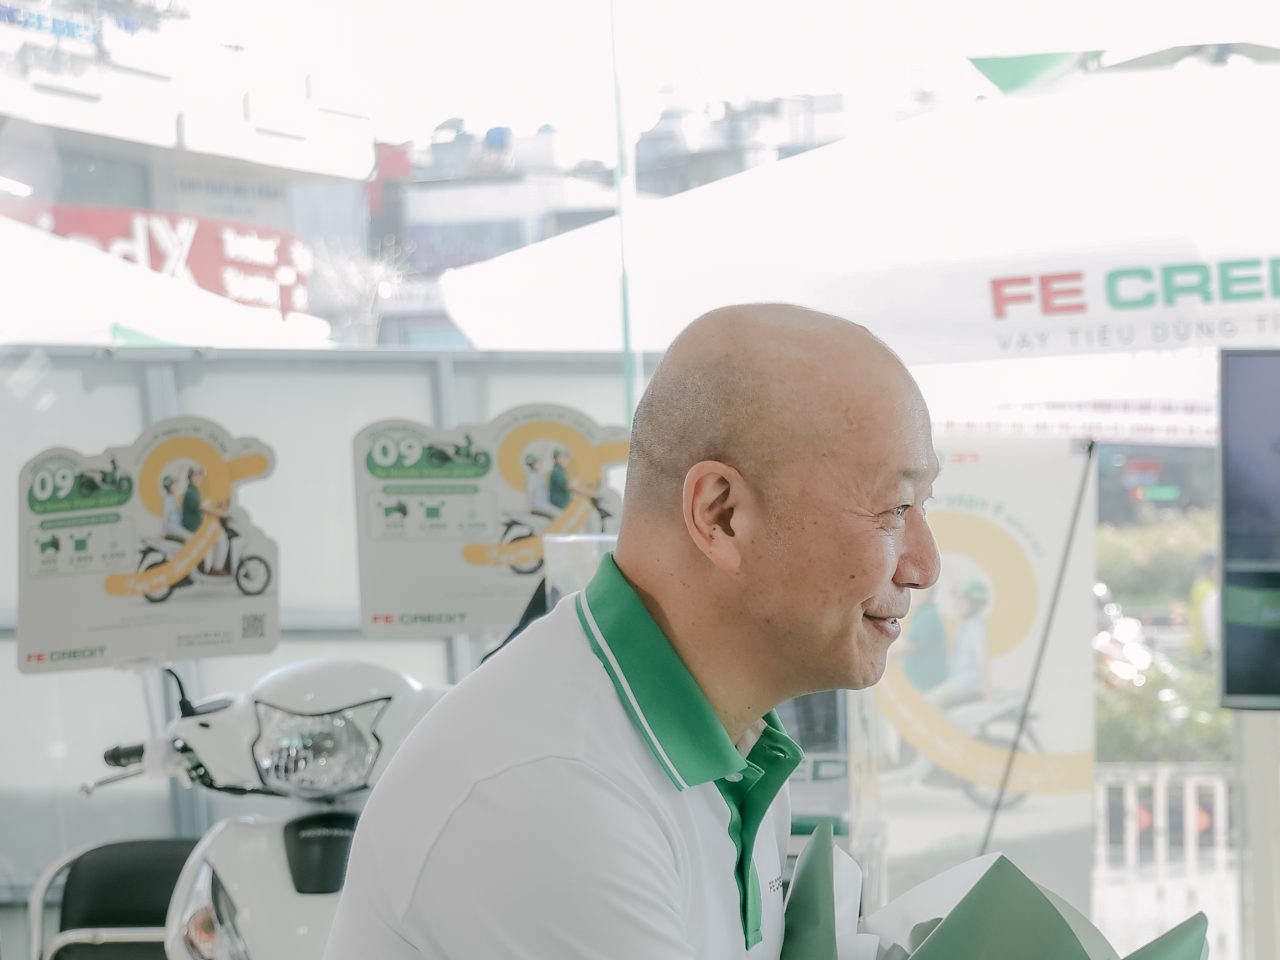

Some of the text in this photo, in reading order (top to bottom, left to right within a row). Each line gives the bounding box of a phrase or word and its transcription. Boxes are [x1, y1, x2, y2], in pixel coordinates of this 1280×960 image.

[990, 272, 1087, 320] FE
[371, 438, 424, 467] 09
[32, 468, 76, 501] 09
